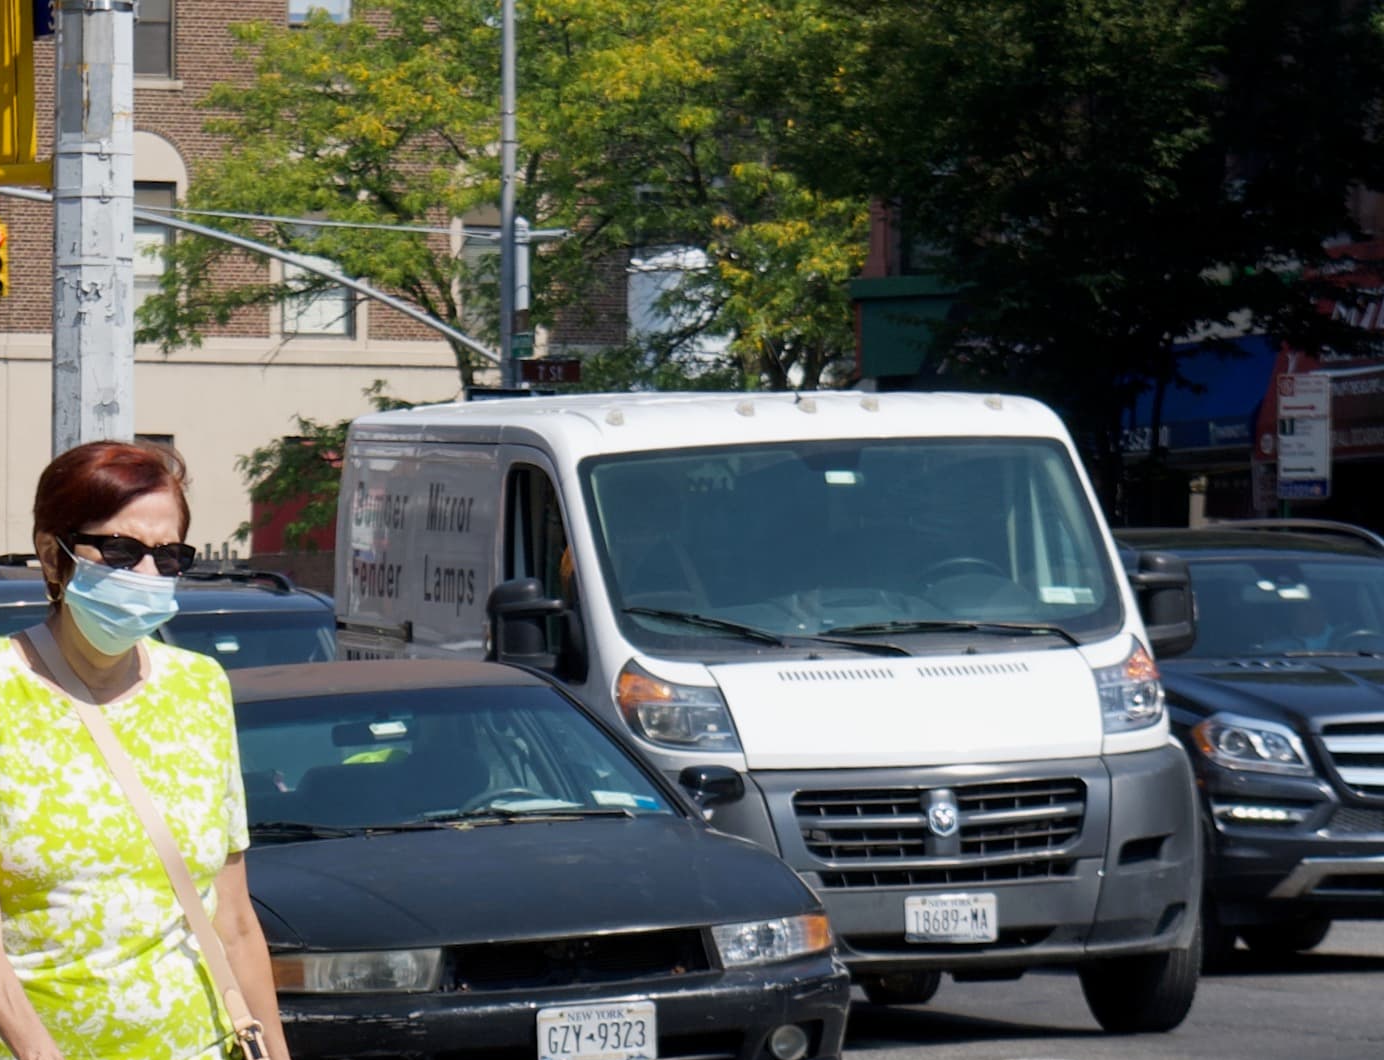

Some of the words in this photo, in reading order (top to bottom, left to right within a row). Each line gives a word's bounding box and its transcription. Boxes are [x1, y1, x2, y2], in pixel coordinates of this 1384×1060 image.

[426, 481, 474, 533] Mirror
[352, 549, 403, 599] Fender
[423, 553, 475, 617] Lamps
[568, 1011, 593, 1021] NEW
[596, 1008, 624, 1019] YORK
[548, 1024, 582, 1054] GZY
[598, 1020, 645, 1050] 9323
